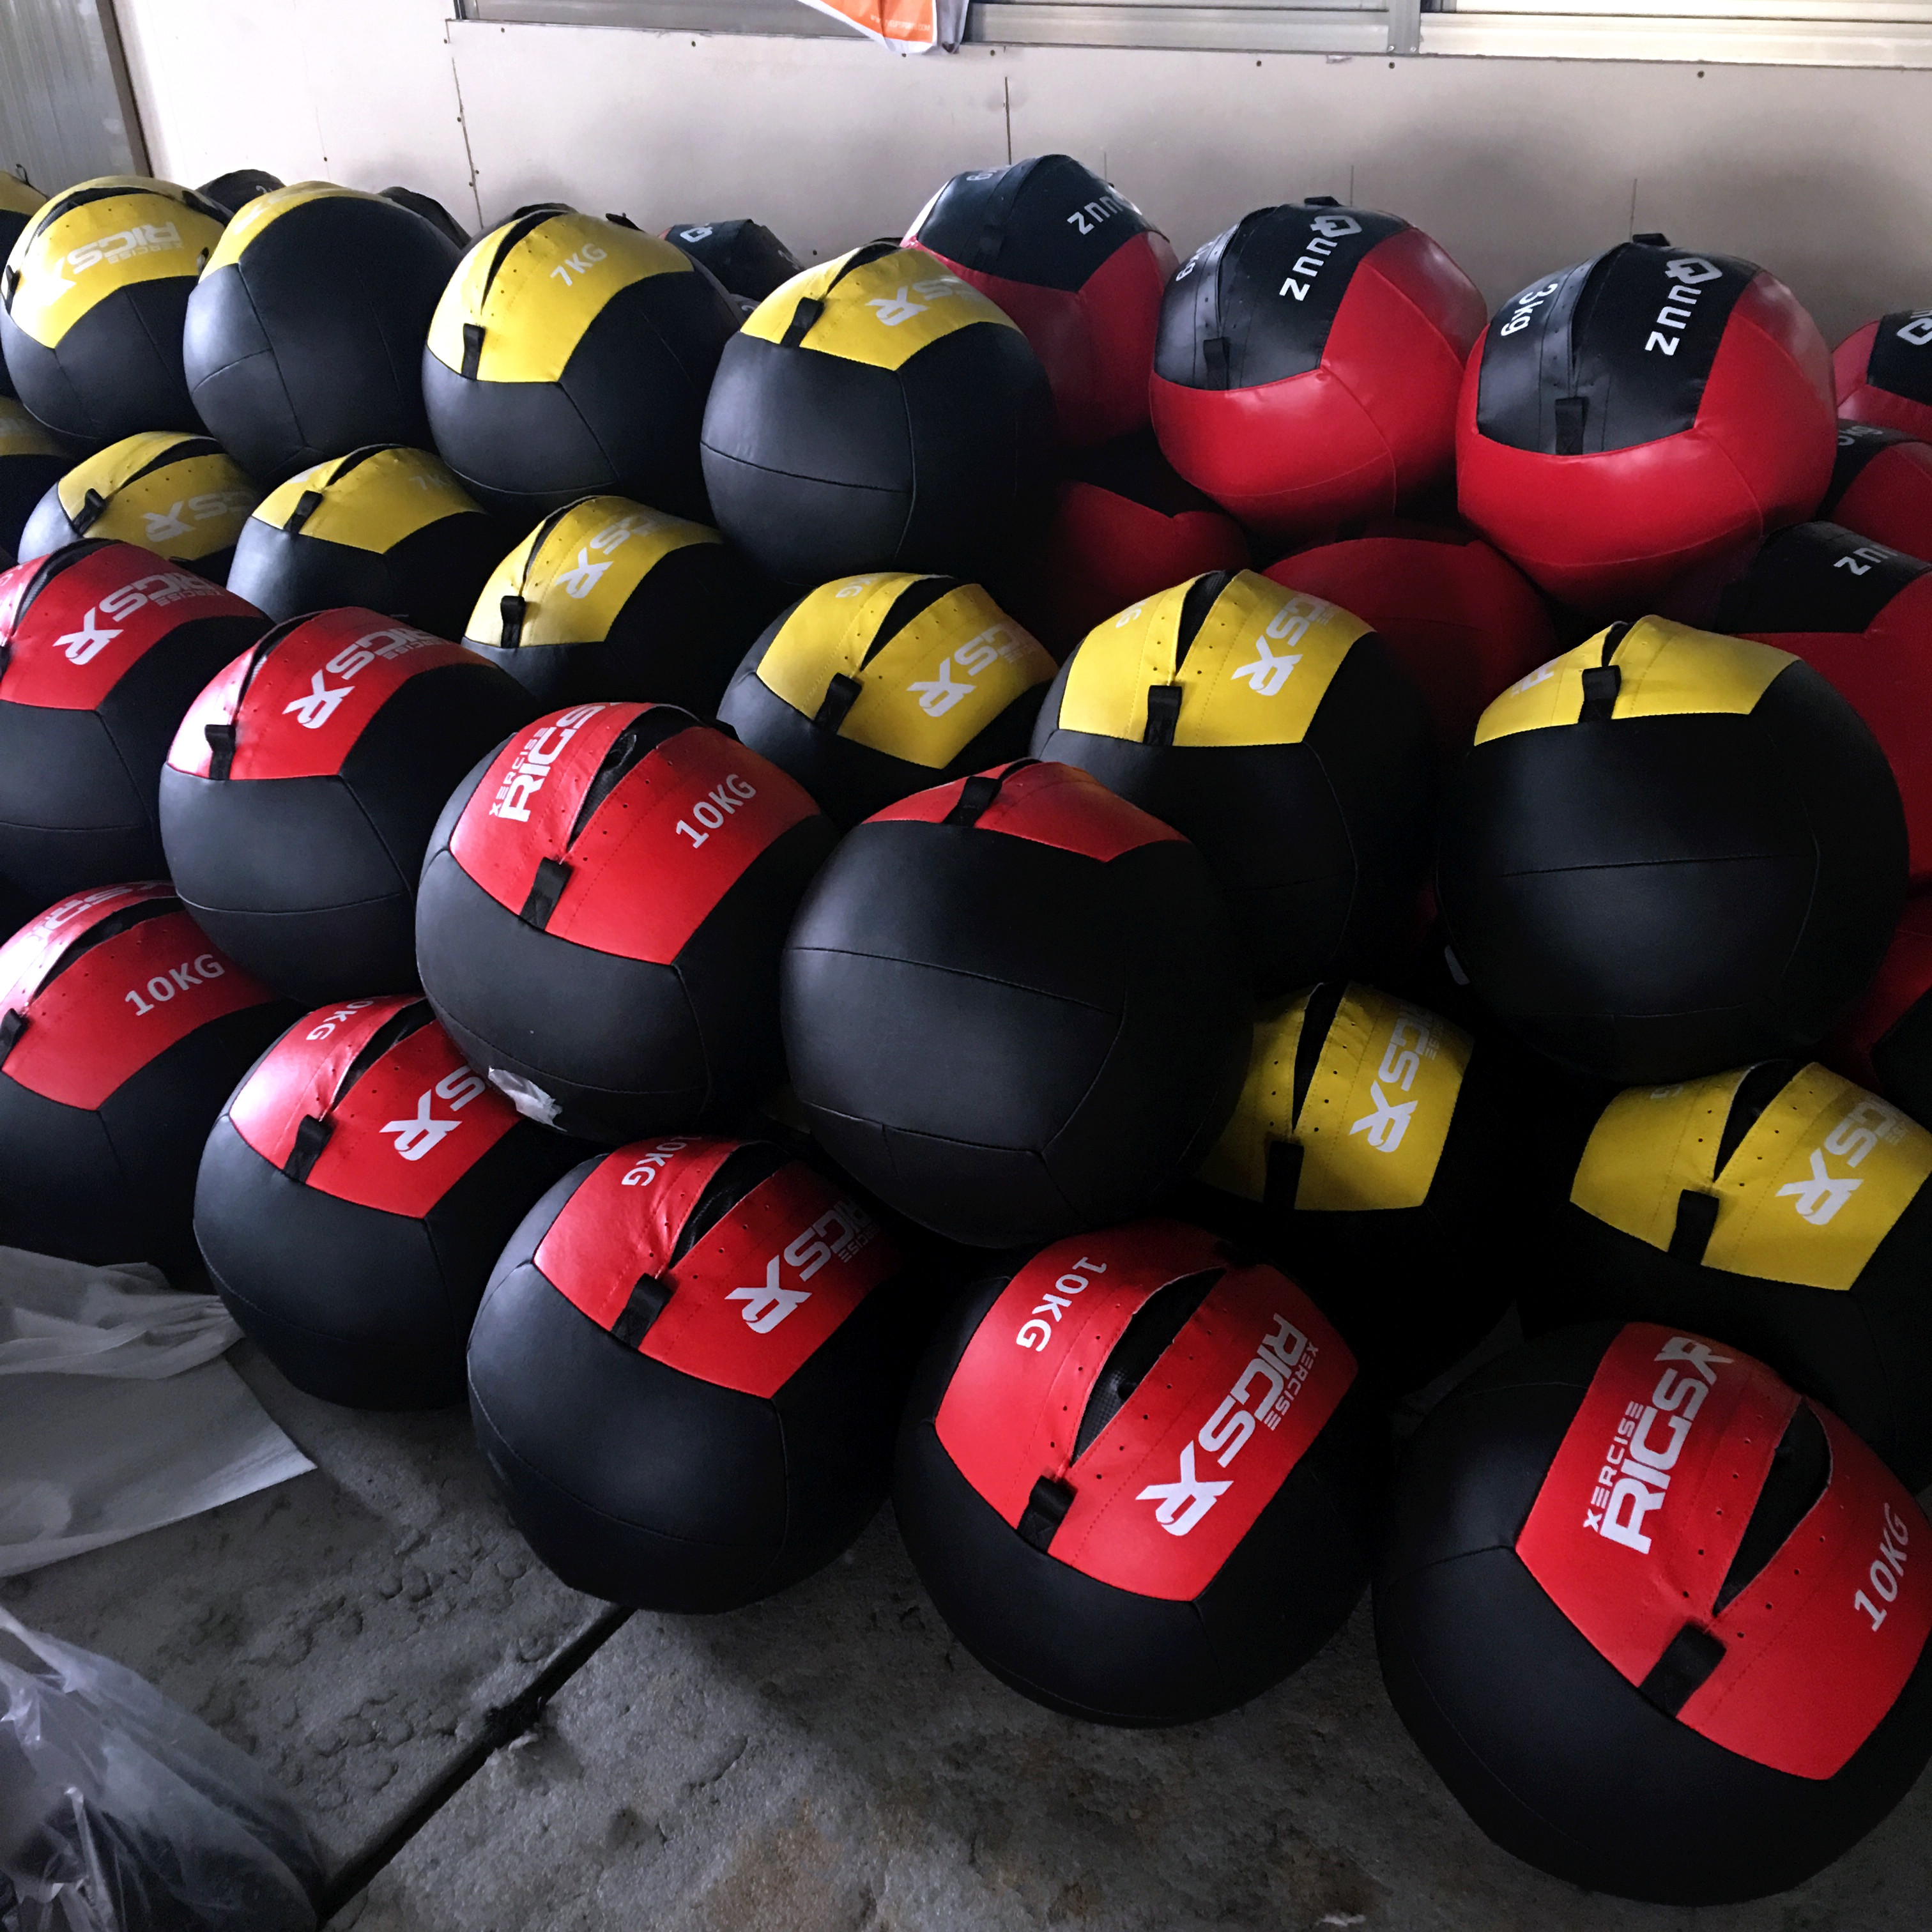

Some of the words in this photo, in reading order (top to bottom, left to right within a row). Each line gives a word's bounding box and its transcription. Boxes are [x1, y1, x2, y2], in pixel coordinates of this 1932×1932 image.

[550, 243, 608, 286] 7KG
[675, 774, 757, 849] 10KG
[125, 953, 226, 1016] 10KG
[1016, 1256, 1107, 1353] 10KG
[1264, 1342, 1319, 1431] XERCISE
[1583, 1400, 1644, 1533] XERCISE
[1853, 1502, 1909, 1632] 10KG
